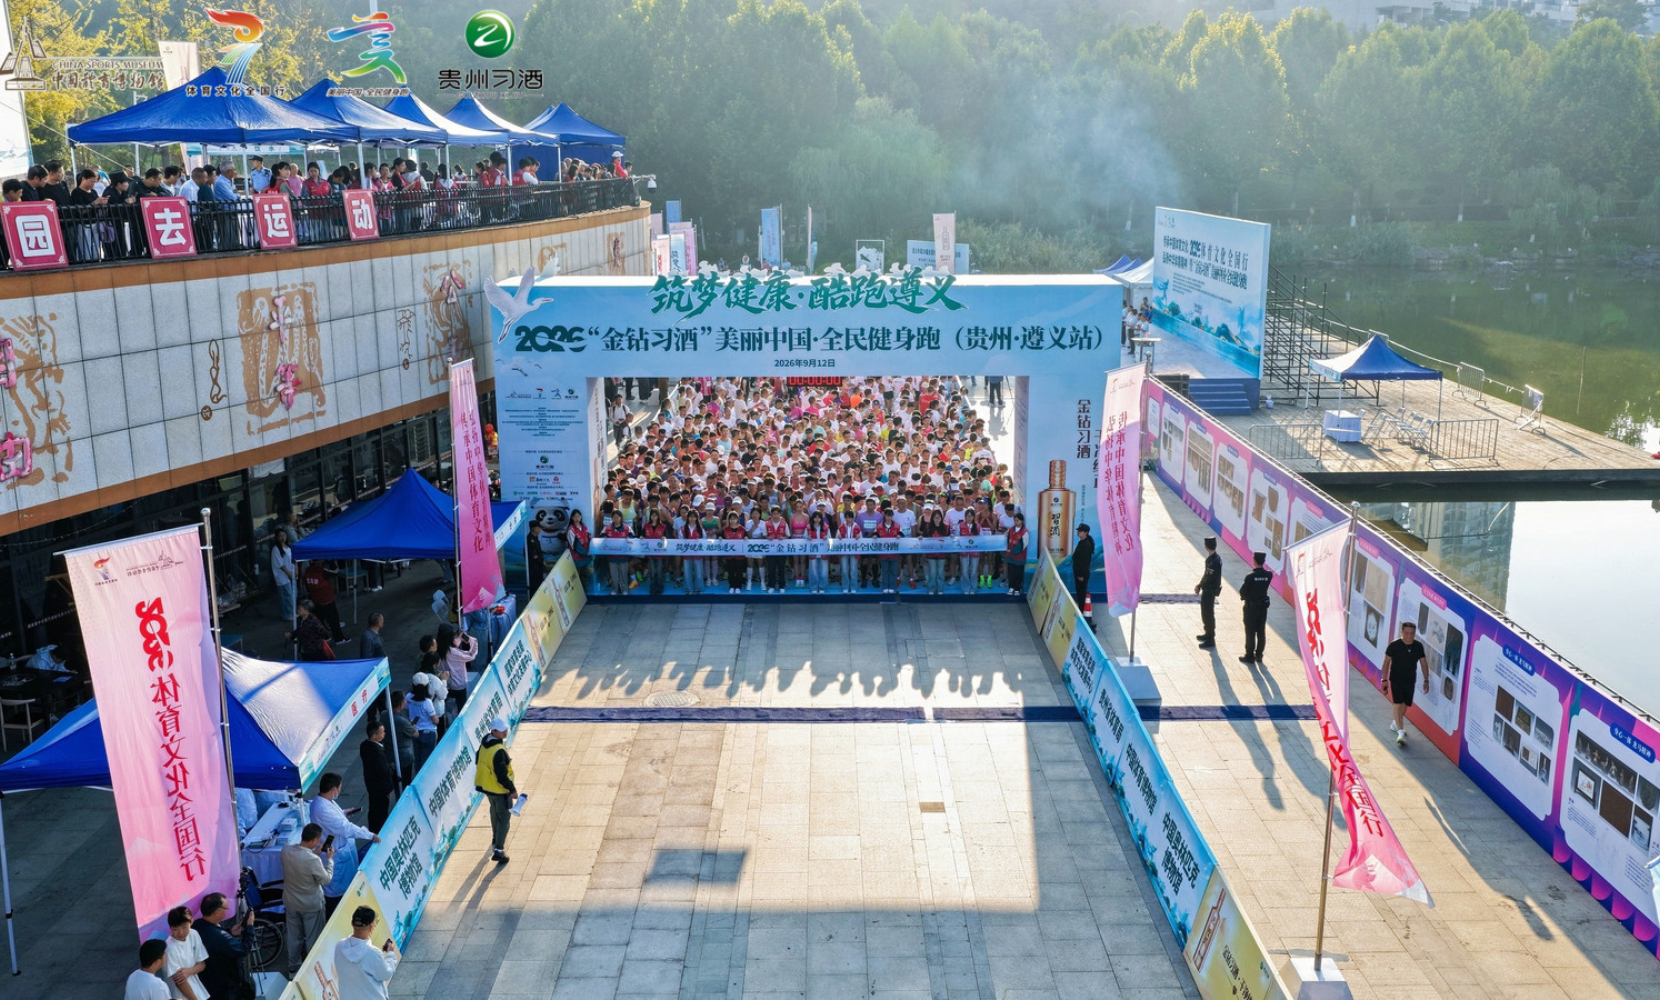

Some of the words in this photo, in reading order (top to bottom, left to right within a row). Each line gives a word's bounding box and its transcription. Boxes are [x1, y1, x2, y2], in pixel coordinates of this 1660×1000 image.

[15, 214, 56, 258] 园
[154, 208, 187, 247] 去
[263, 203, 290, 238] 运
[351, 198, 374, 230] 动
[648, 267, 969, 325] 筑梦健康·酷跑遵义
[774, 358, 836, 368] 2026年9月12日
[1076, 398, 1091, 459] 金钻习酒
[428, 745, 473, 818] 中国体育博物馆
[1126, 742, 1158, 816] 中国体育博物馆
[379, 814, 422, 891] 中国奥林匹克
[397, 852, 424, 900] 博物馆
[1160, 846, 1184, 896] 博物馆
[1162, 811, 1201, 890] 中国奥林匹克
